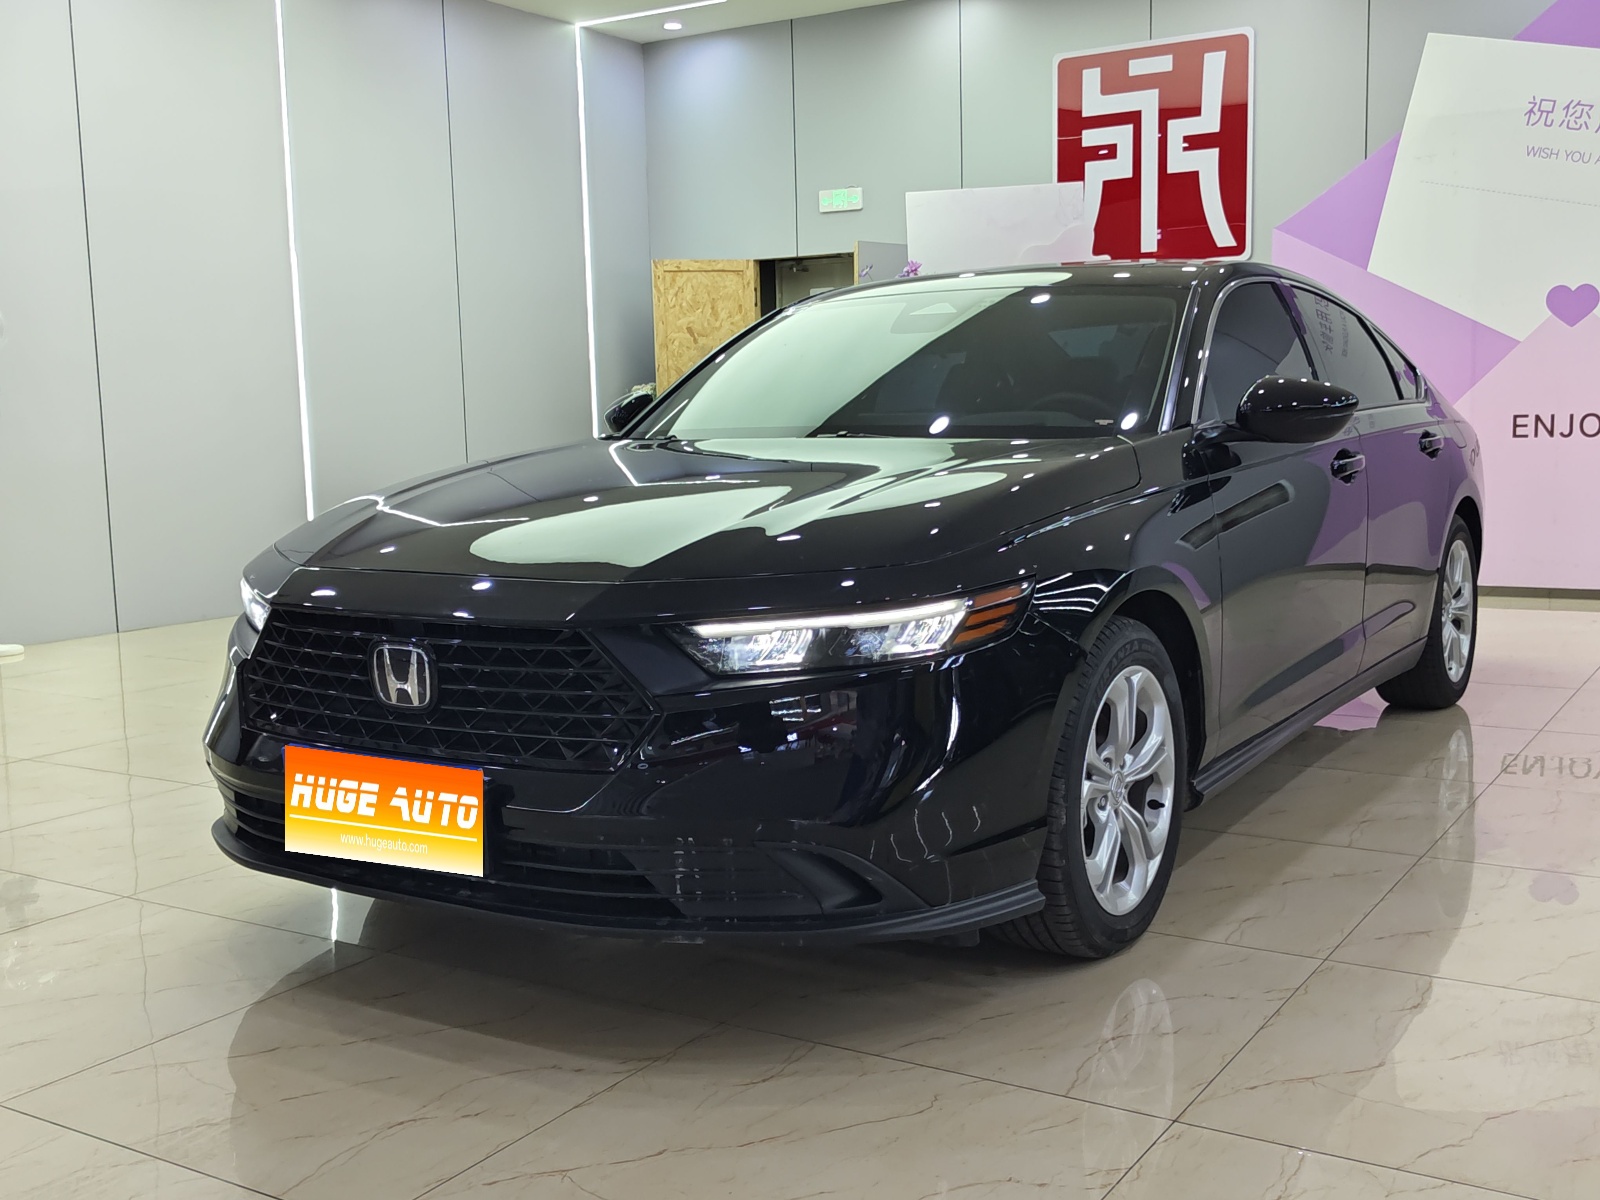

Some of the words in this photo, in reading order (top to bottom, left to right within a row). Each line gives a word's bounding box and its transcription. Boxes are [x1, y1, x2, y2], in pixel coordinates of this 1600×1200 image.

[1523, 95, 1600, 133] 祝您
[1525, 144, 1561, 161] WISH
[1564, 149, 1593, 165] YOU
[1511, 412, 1600, 439] ENJO
